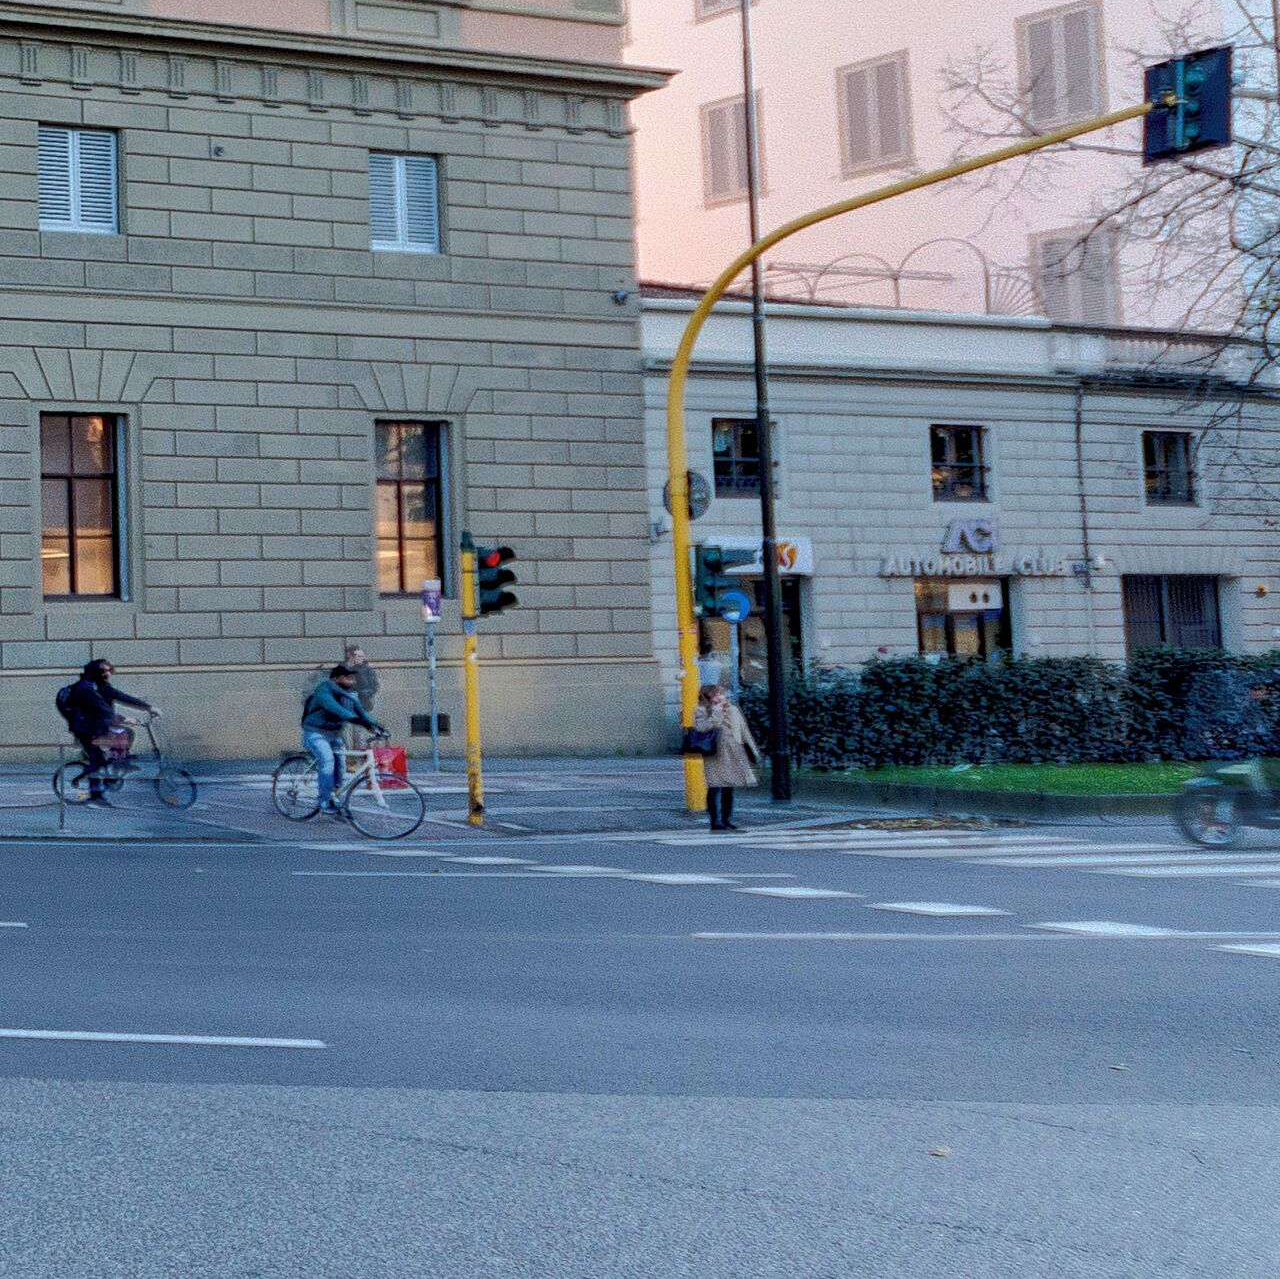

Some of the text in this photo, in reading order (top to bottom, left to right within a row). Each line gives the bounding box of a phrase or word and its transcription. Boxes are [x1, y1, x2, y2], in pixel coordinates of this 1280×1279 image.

[941, 519, 998, 553] ACI
[882, 555, 1067, 576] AUTOMOBILE CLUB
